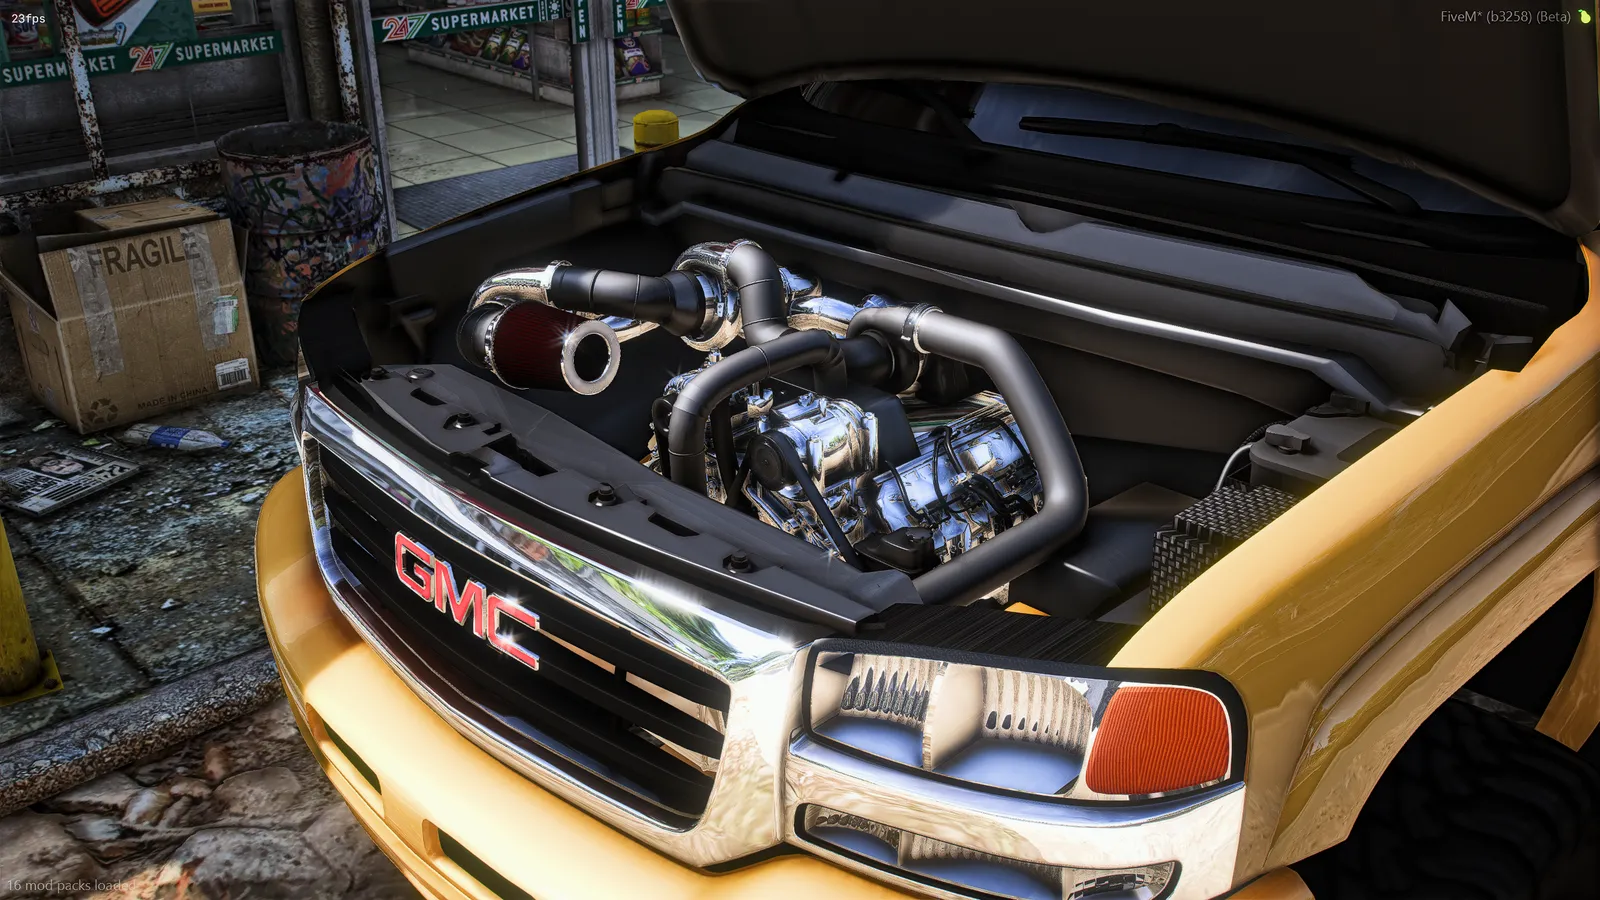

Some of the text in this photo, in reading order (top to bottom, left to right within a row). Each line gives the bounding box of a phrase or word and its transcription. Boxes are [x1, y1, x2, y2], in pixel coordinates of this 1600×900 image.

[431, 5, 535, 31] SUPERMARKET
[616, 0, 625, 33] EN
[2, 55, 117, 83] SUPERMKET
[176, 35, 275, 61] SUPERMARKET
[137, 385, 209, 410] MADE IN CHINA
[395, 531, 541, 672] GMC
